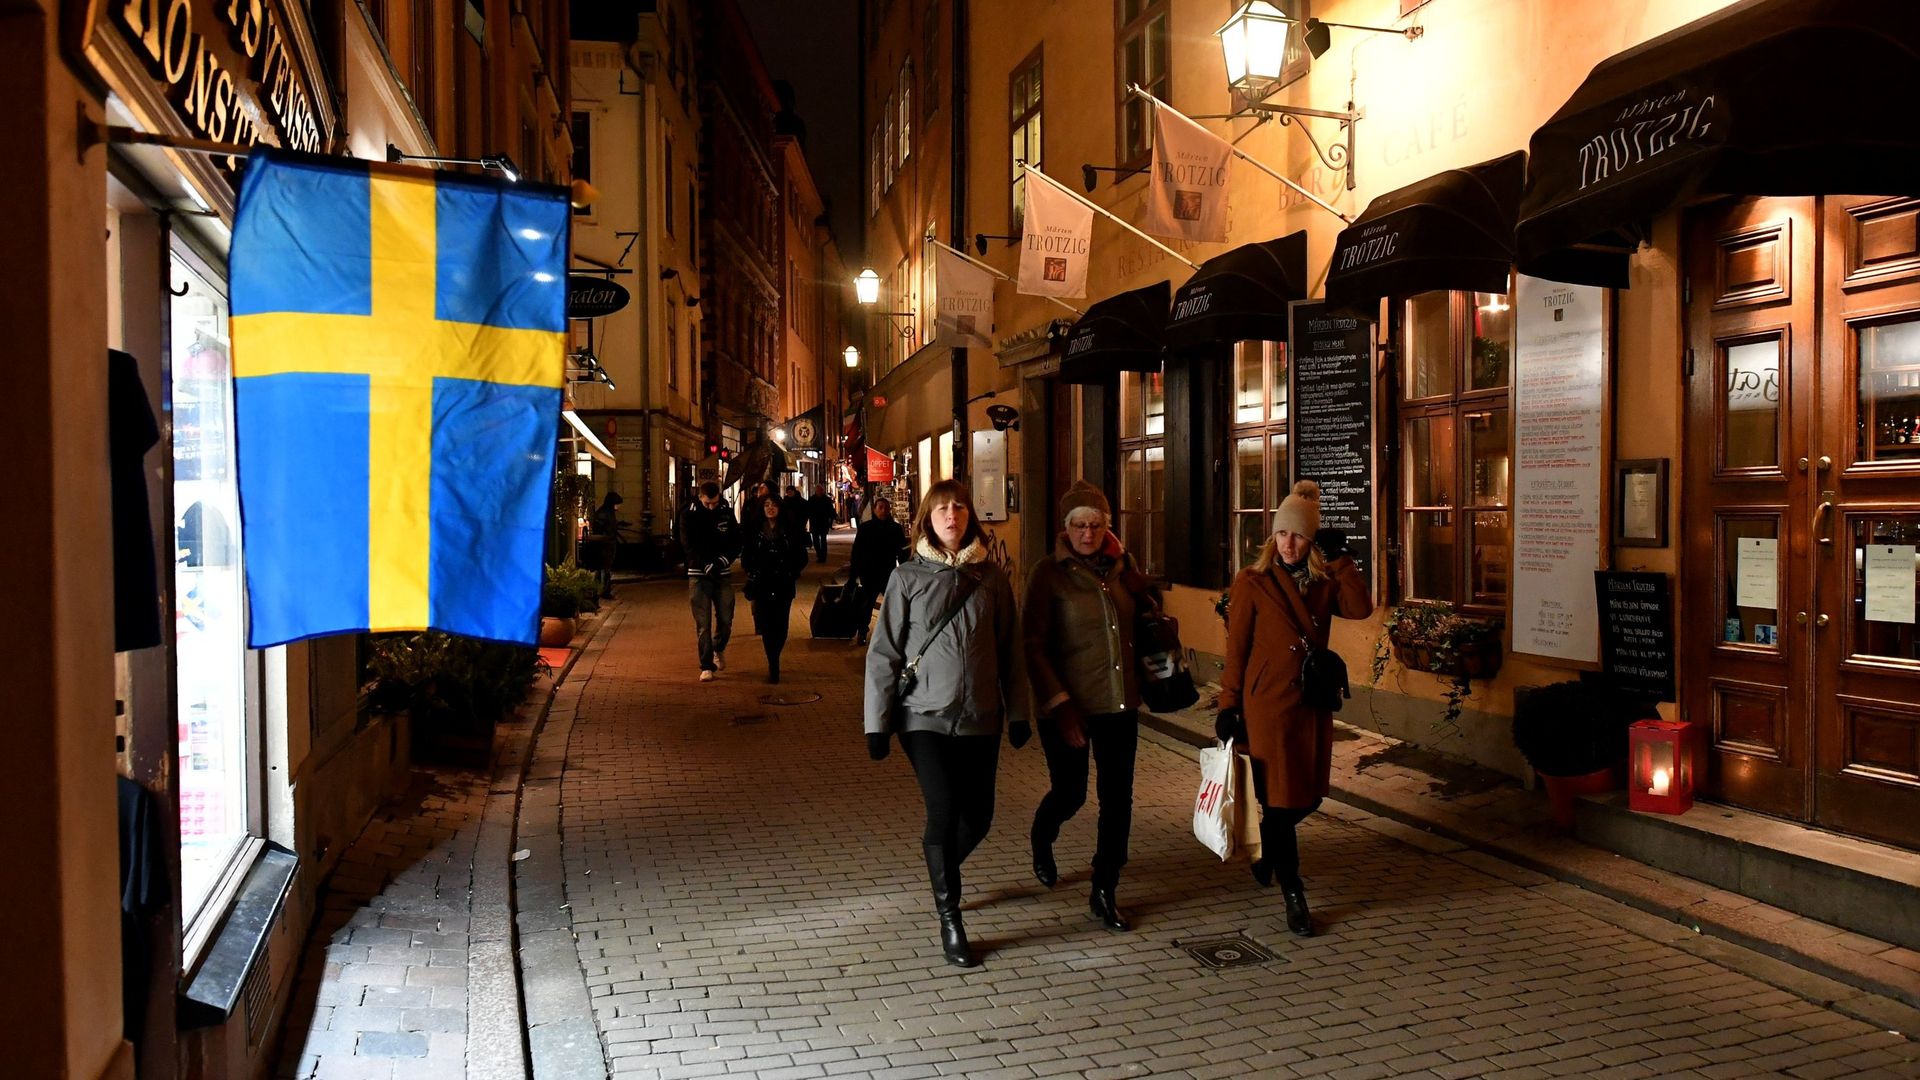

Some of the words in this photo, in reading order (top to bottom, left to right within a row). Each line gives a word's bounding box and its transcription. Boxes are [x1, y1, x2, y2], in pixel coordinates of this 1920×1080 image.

[1383, 95, 1468, 167] CAFÉ
[1579, 95, 1715, 190] TROTZIG
[1157, 162, 1226, 187] TROTZIG
[1278, 166, 1325, 212] BAR
[1027, 234, 1087, 255] TROTZIG
[1340, 232, 1399, 270] TROTZIG
[942, 297, 991, 312] TROTZIG
[1174, 293, 1213, 321] TROTZIG
[1543, 291, 1575, 309] TROTZIG
